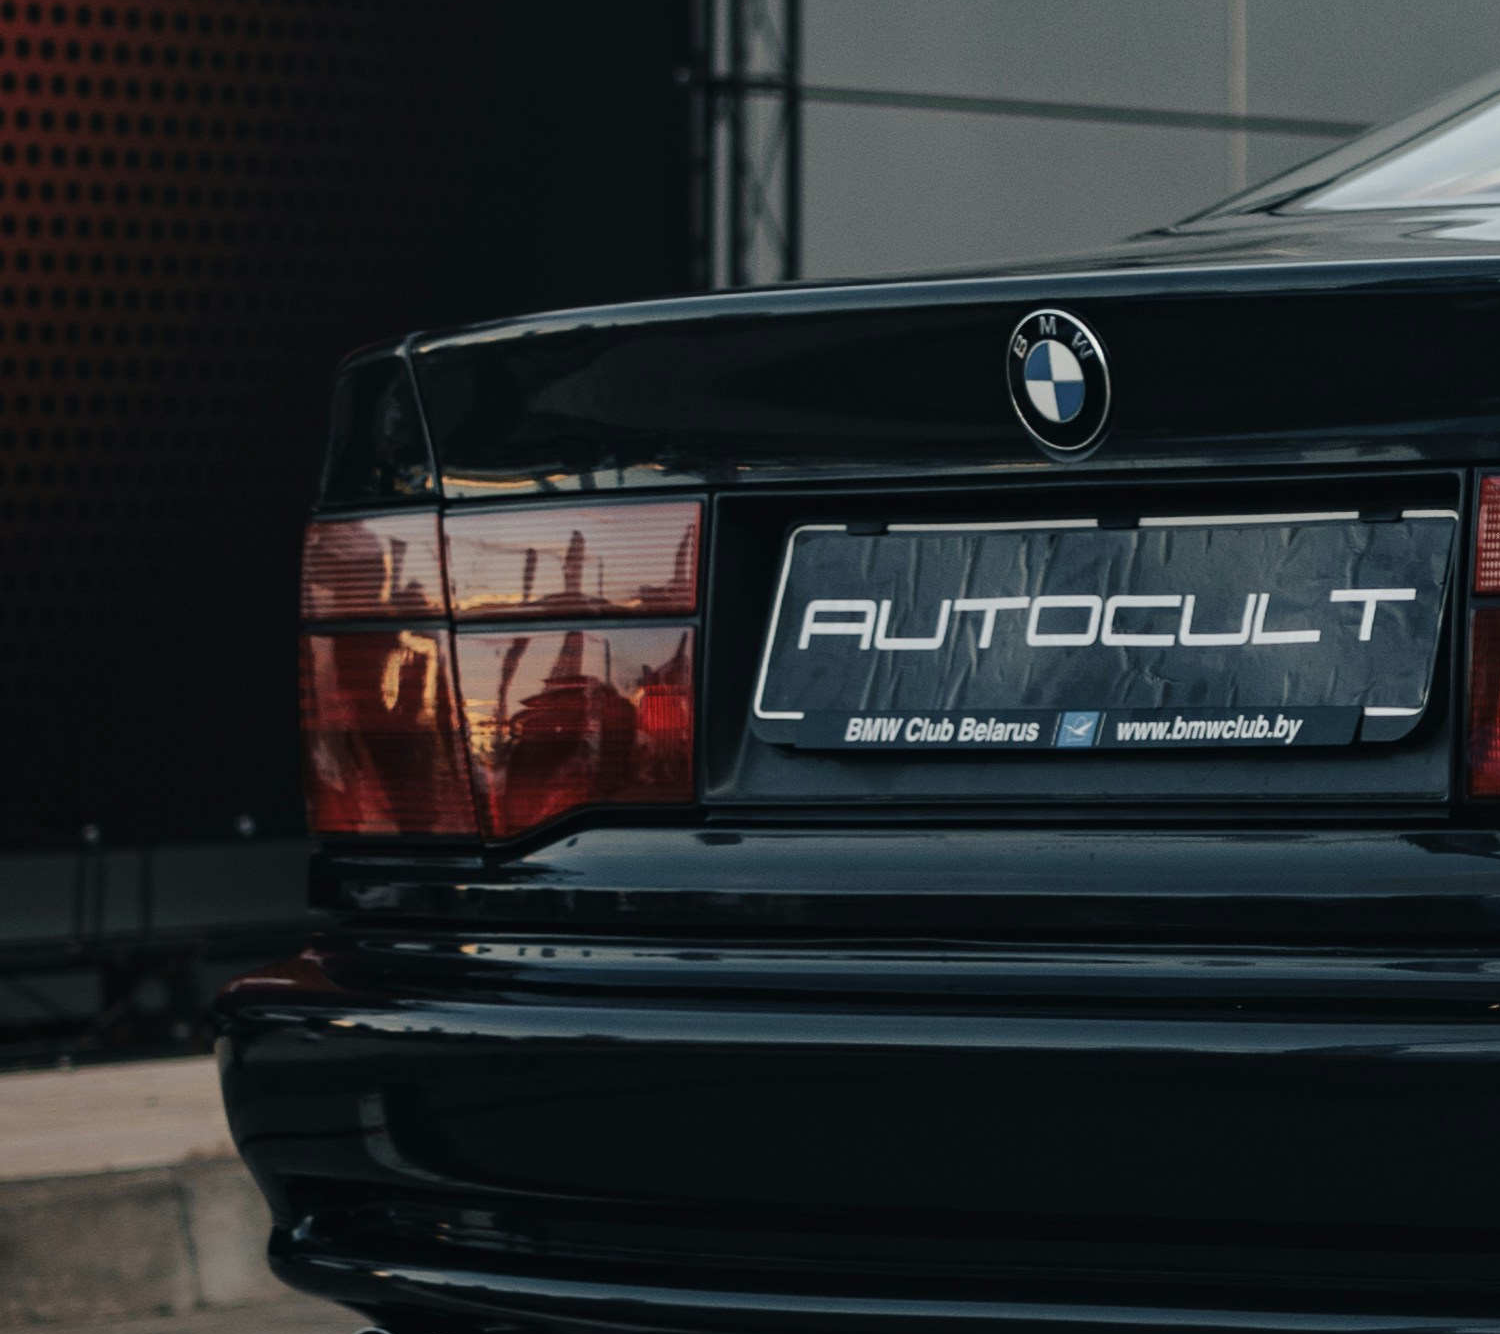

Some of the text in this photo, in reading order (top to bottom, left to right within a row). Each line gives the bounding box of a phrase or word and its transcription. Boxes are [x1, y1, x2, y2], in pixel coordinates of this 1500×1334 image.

[1013, 316, 1093, 359] BMW
[798, 588, 1417, 651] AUTOCULT
[844, 714, 1304, 745] BMW Club Belarus www.bmwclub.by
